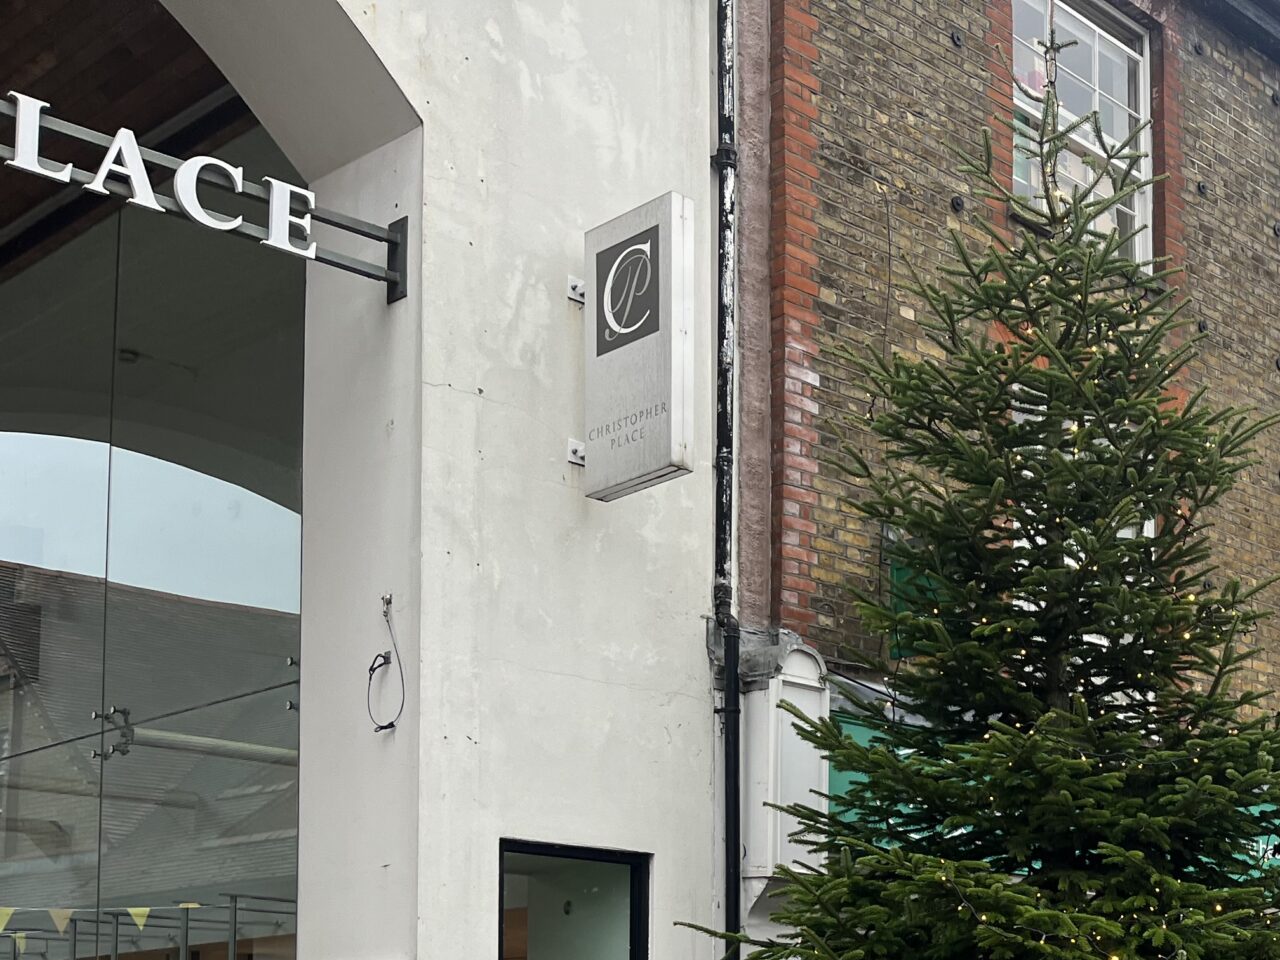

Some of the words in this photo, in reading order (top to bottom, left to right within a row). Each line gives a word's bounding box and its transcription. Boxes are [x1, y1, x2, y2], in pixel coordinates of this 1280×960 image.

[5, 90, 317, 260] LACE
[588, 402, 667, 441] CHRISTOPHER
[610, 426, 646, 450] PLACE
